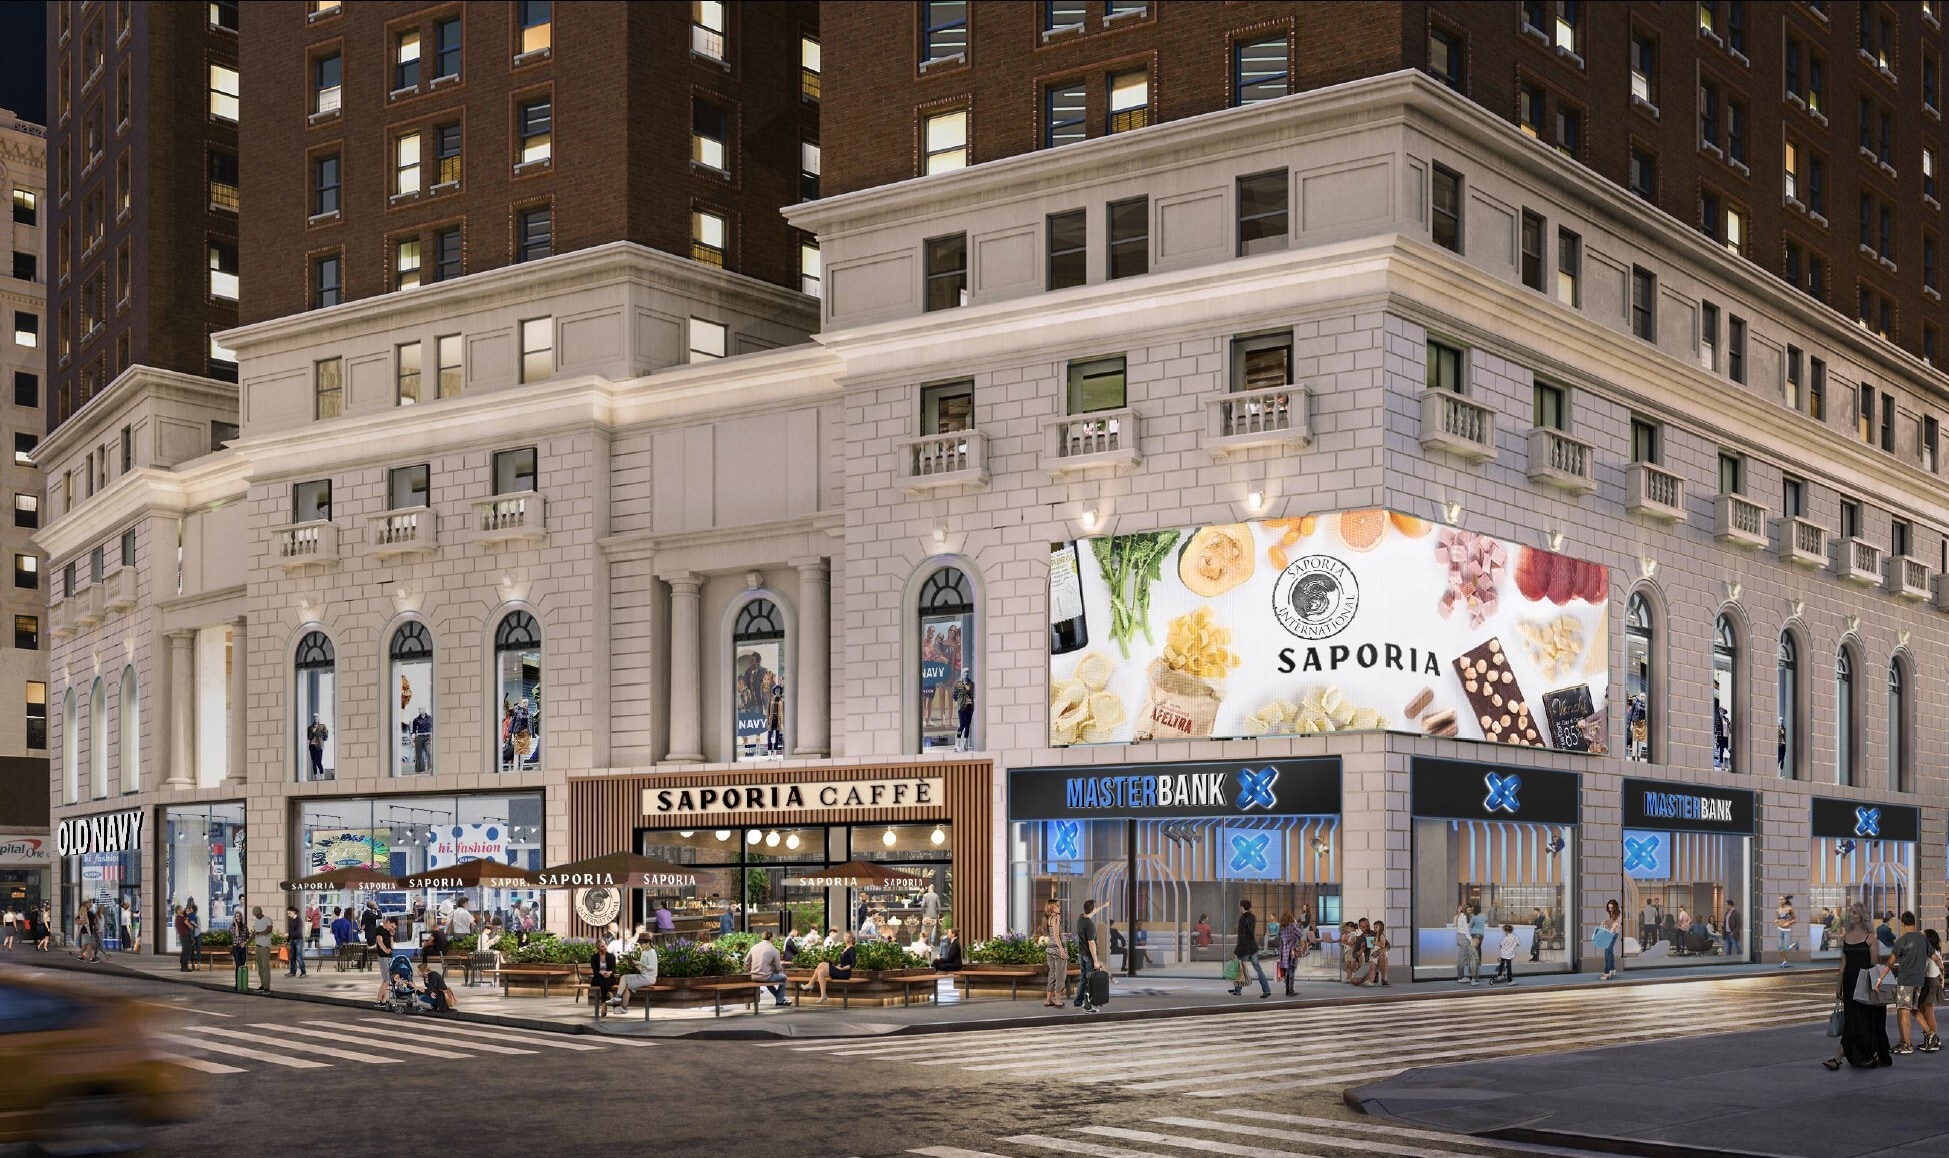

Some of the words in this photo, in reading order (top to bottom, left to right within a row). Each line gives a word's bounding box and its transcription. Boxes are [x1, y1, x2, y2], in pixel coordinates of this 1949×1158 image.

[1287, 558, 1345, 578] SAPORIA
[1279, 595, 1356, 636] INTERNATIONAL
[1277, 643, 1441, 677] SAPORIA
[738, 718, 768, 729] NAVY
[657, 786, 804, 811] SAPORIA
[819, 779, 931, 806] CAFFÈ
[1066, 773, 1227, 808] MASTERBANK
[1644, 791, 1732, 821] MASTERBANK
[57, 819, 91, 856] OLD
[92, 811, 144, 853] NAVY
[0, 843, 25, 855] pital
[26, 847, 45, 858] One
[454, 841, 501, 855] fashion
[358, 882, 396, 890] SAPORIA
[408, 878, 463, 888] SAPORIA
[491, 878, 537, 887] SAPOR
[539, 873, 614, 885] SAPORIA
[643, 873, 696, 885] SAPORIA
[800, 877, 858, 886] SAPORIA
[884, 878, 923, 887] SAPORIA
[291, 882, 335, 891] SAPORIA
[577, 901, 620, 925] INTERNATIONAL
